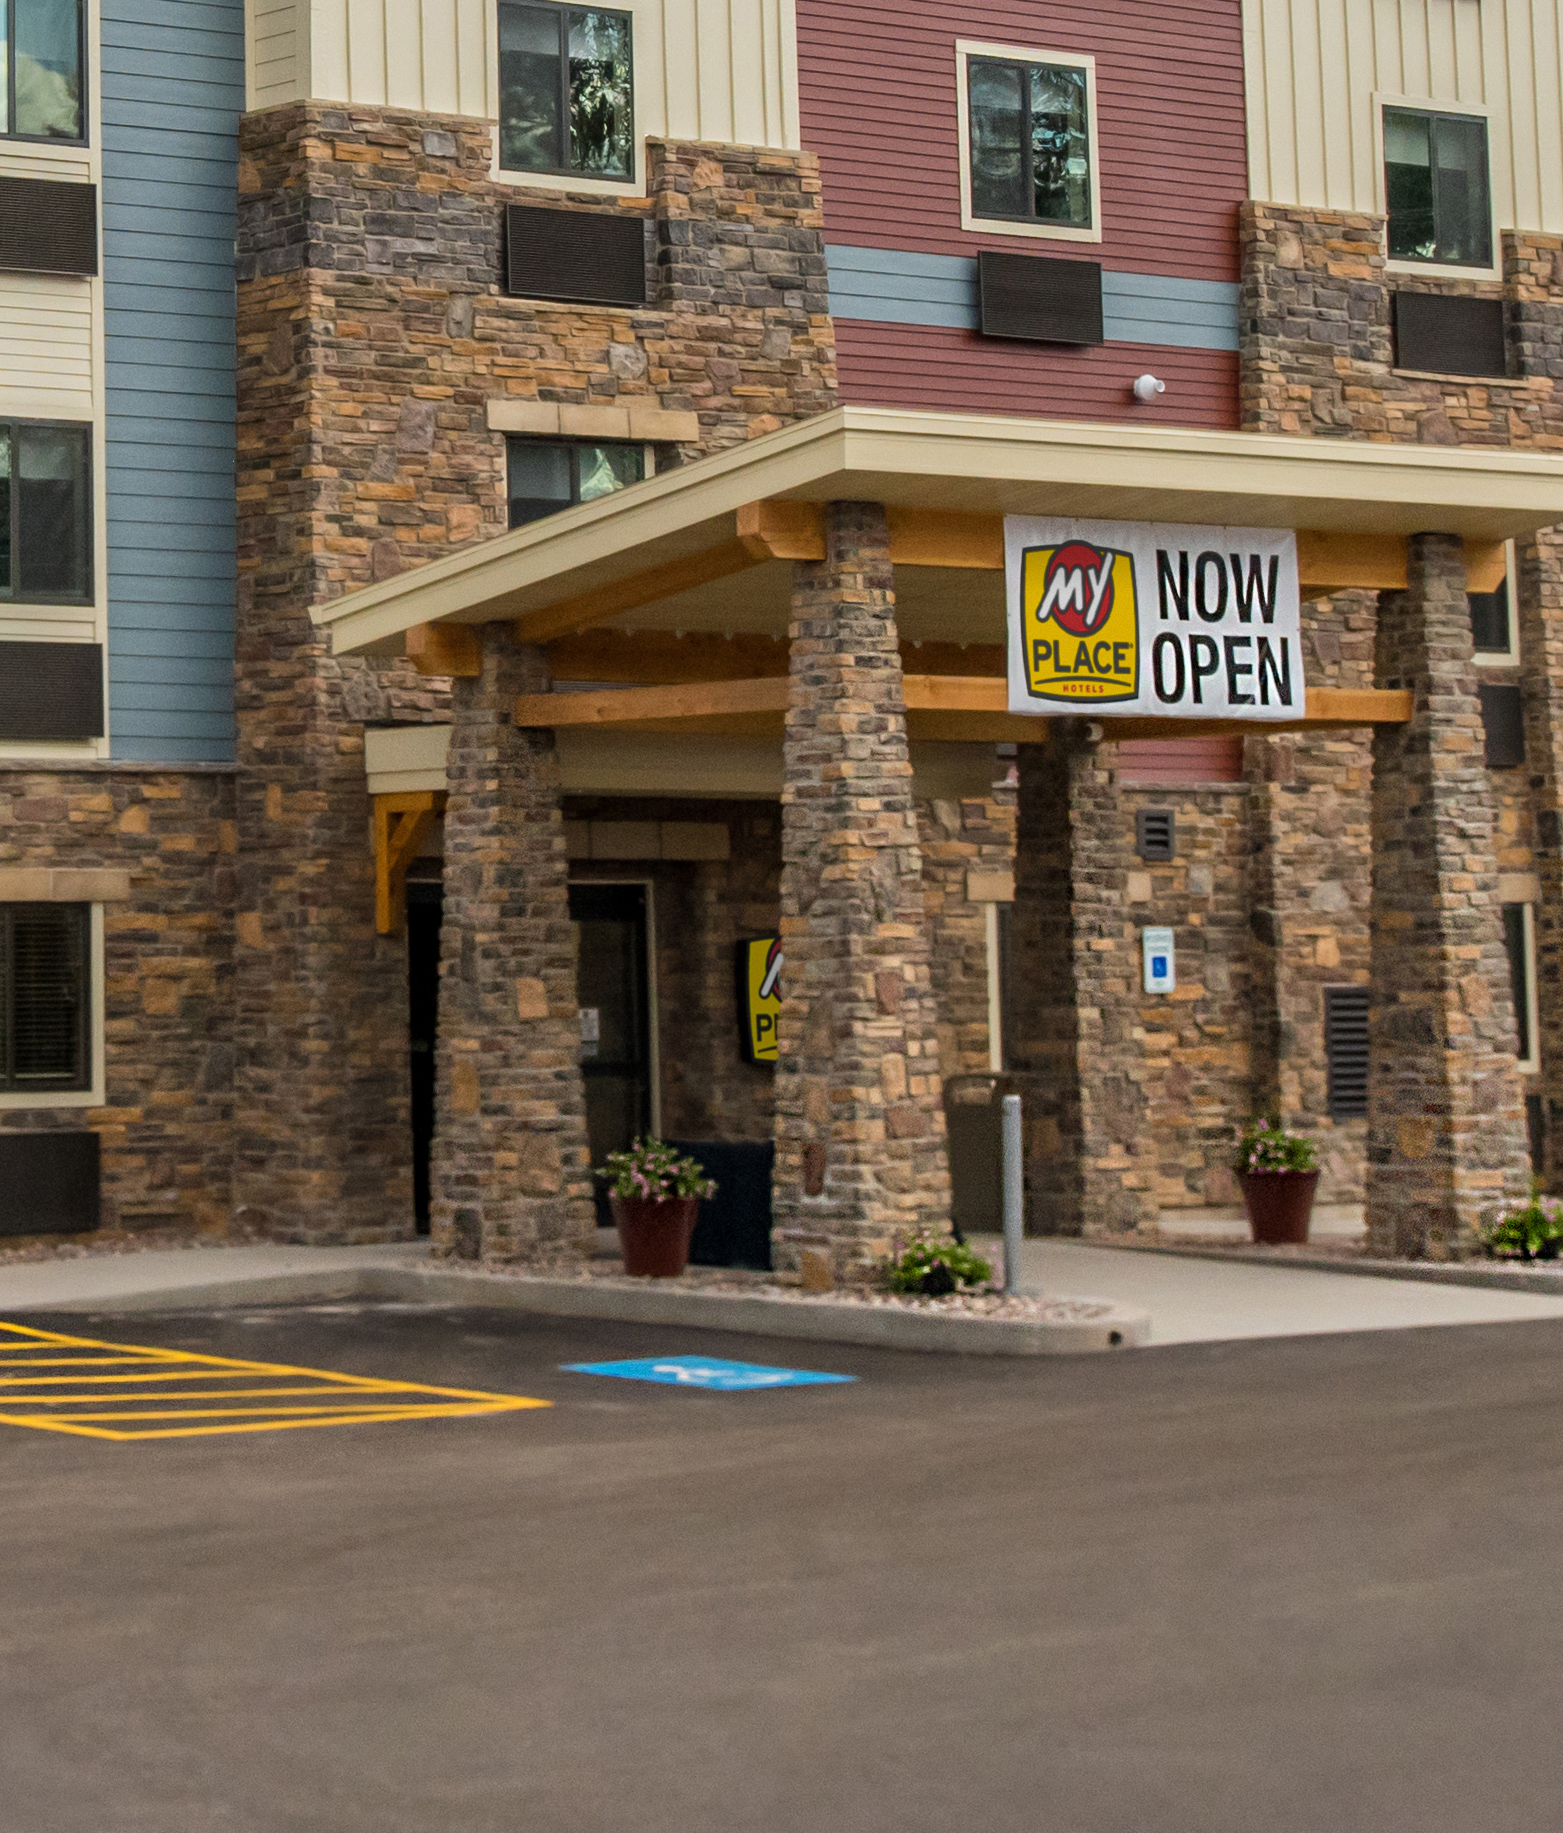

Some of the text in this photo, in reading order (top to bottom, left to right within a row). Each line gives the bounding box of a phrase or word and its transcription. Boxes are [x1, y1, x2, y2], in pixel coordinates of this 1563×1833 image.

[1156, 548, 1279, 624] NOW
[1032, 639, 1132, 675] PLACE
[1152, 631, 1293, 707] OPEN
[1062, 684, 1105, 694] HOTELS
